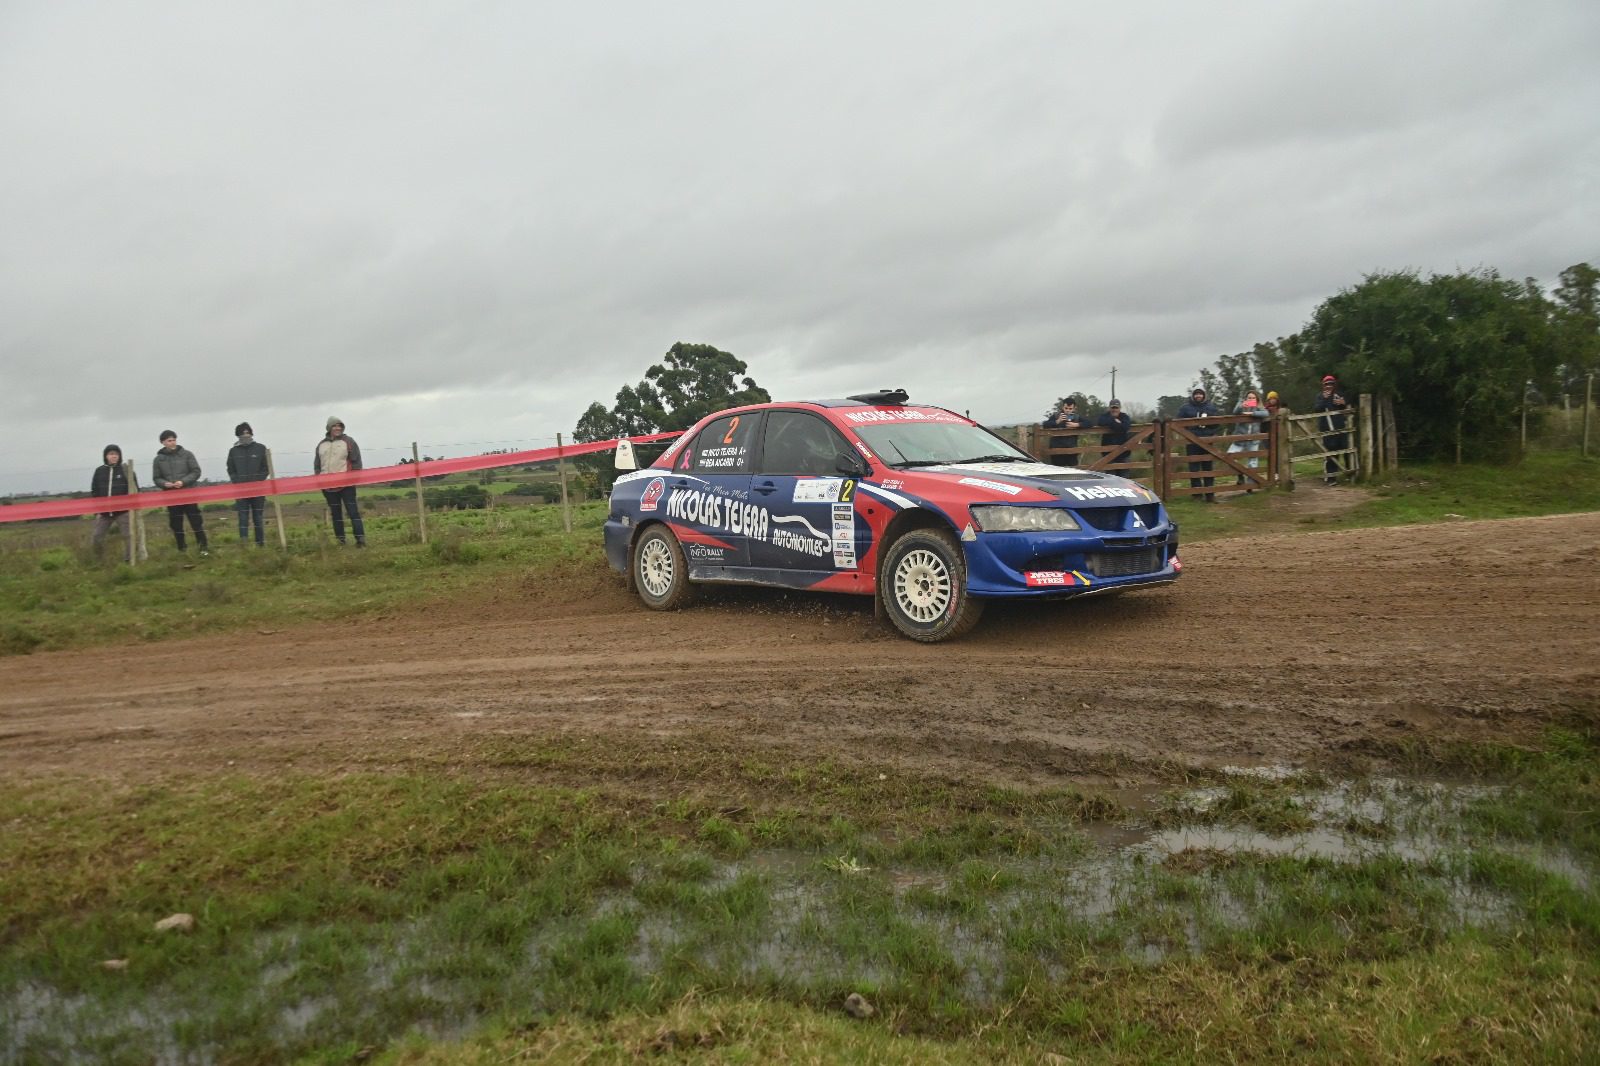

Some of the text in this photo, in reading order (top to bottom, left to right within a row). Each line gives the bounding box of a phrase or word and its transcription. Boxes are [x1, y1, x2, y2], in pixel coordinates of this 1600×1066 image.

[723, 416, 741, 444] 2
[841, 479, 854, 502] 2
[1064, 485, 1138, 501] Heliar
[666, 488, 769, 542] NICOLAS TEJERA
[772, 528, 823, 557] AUTOMOVILES
